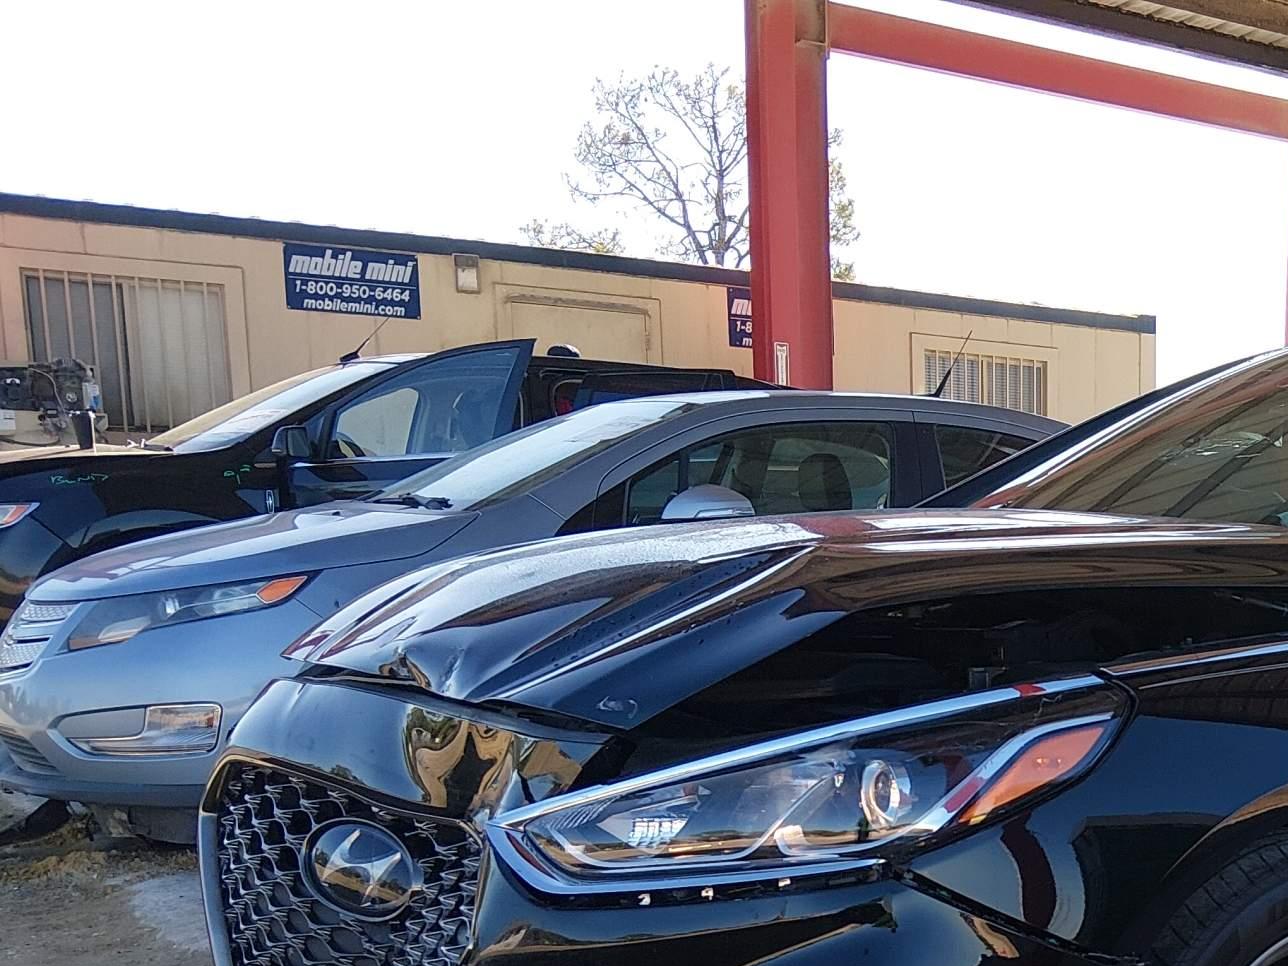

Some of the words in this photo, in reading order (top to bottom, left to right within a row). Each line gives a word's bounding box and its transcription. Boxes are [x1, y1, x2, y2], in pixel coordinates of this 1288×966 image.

[289, 249, 362, 279] mobile
[365, 259, 413, 283] mini
[295, 280, 410, 302] 1-800-950-6464
[303, 298, 405, 316] mobilemini.com
